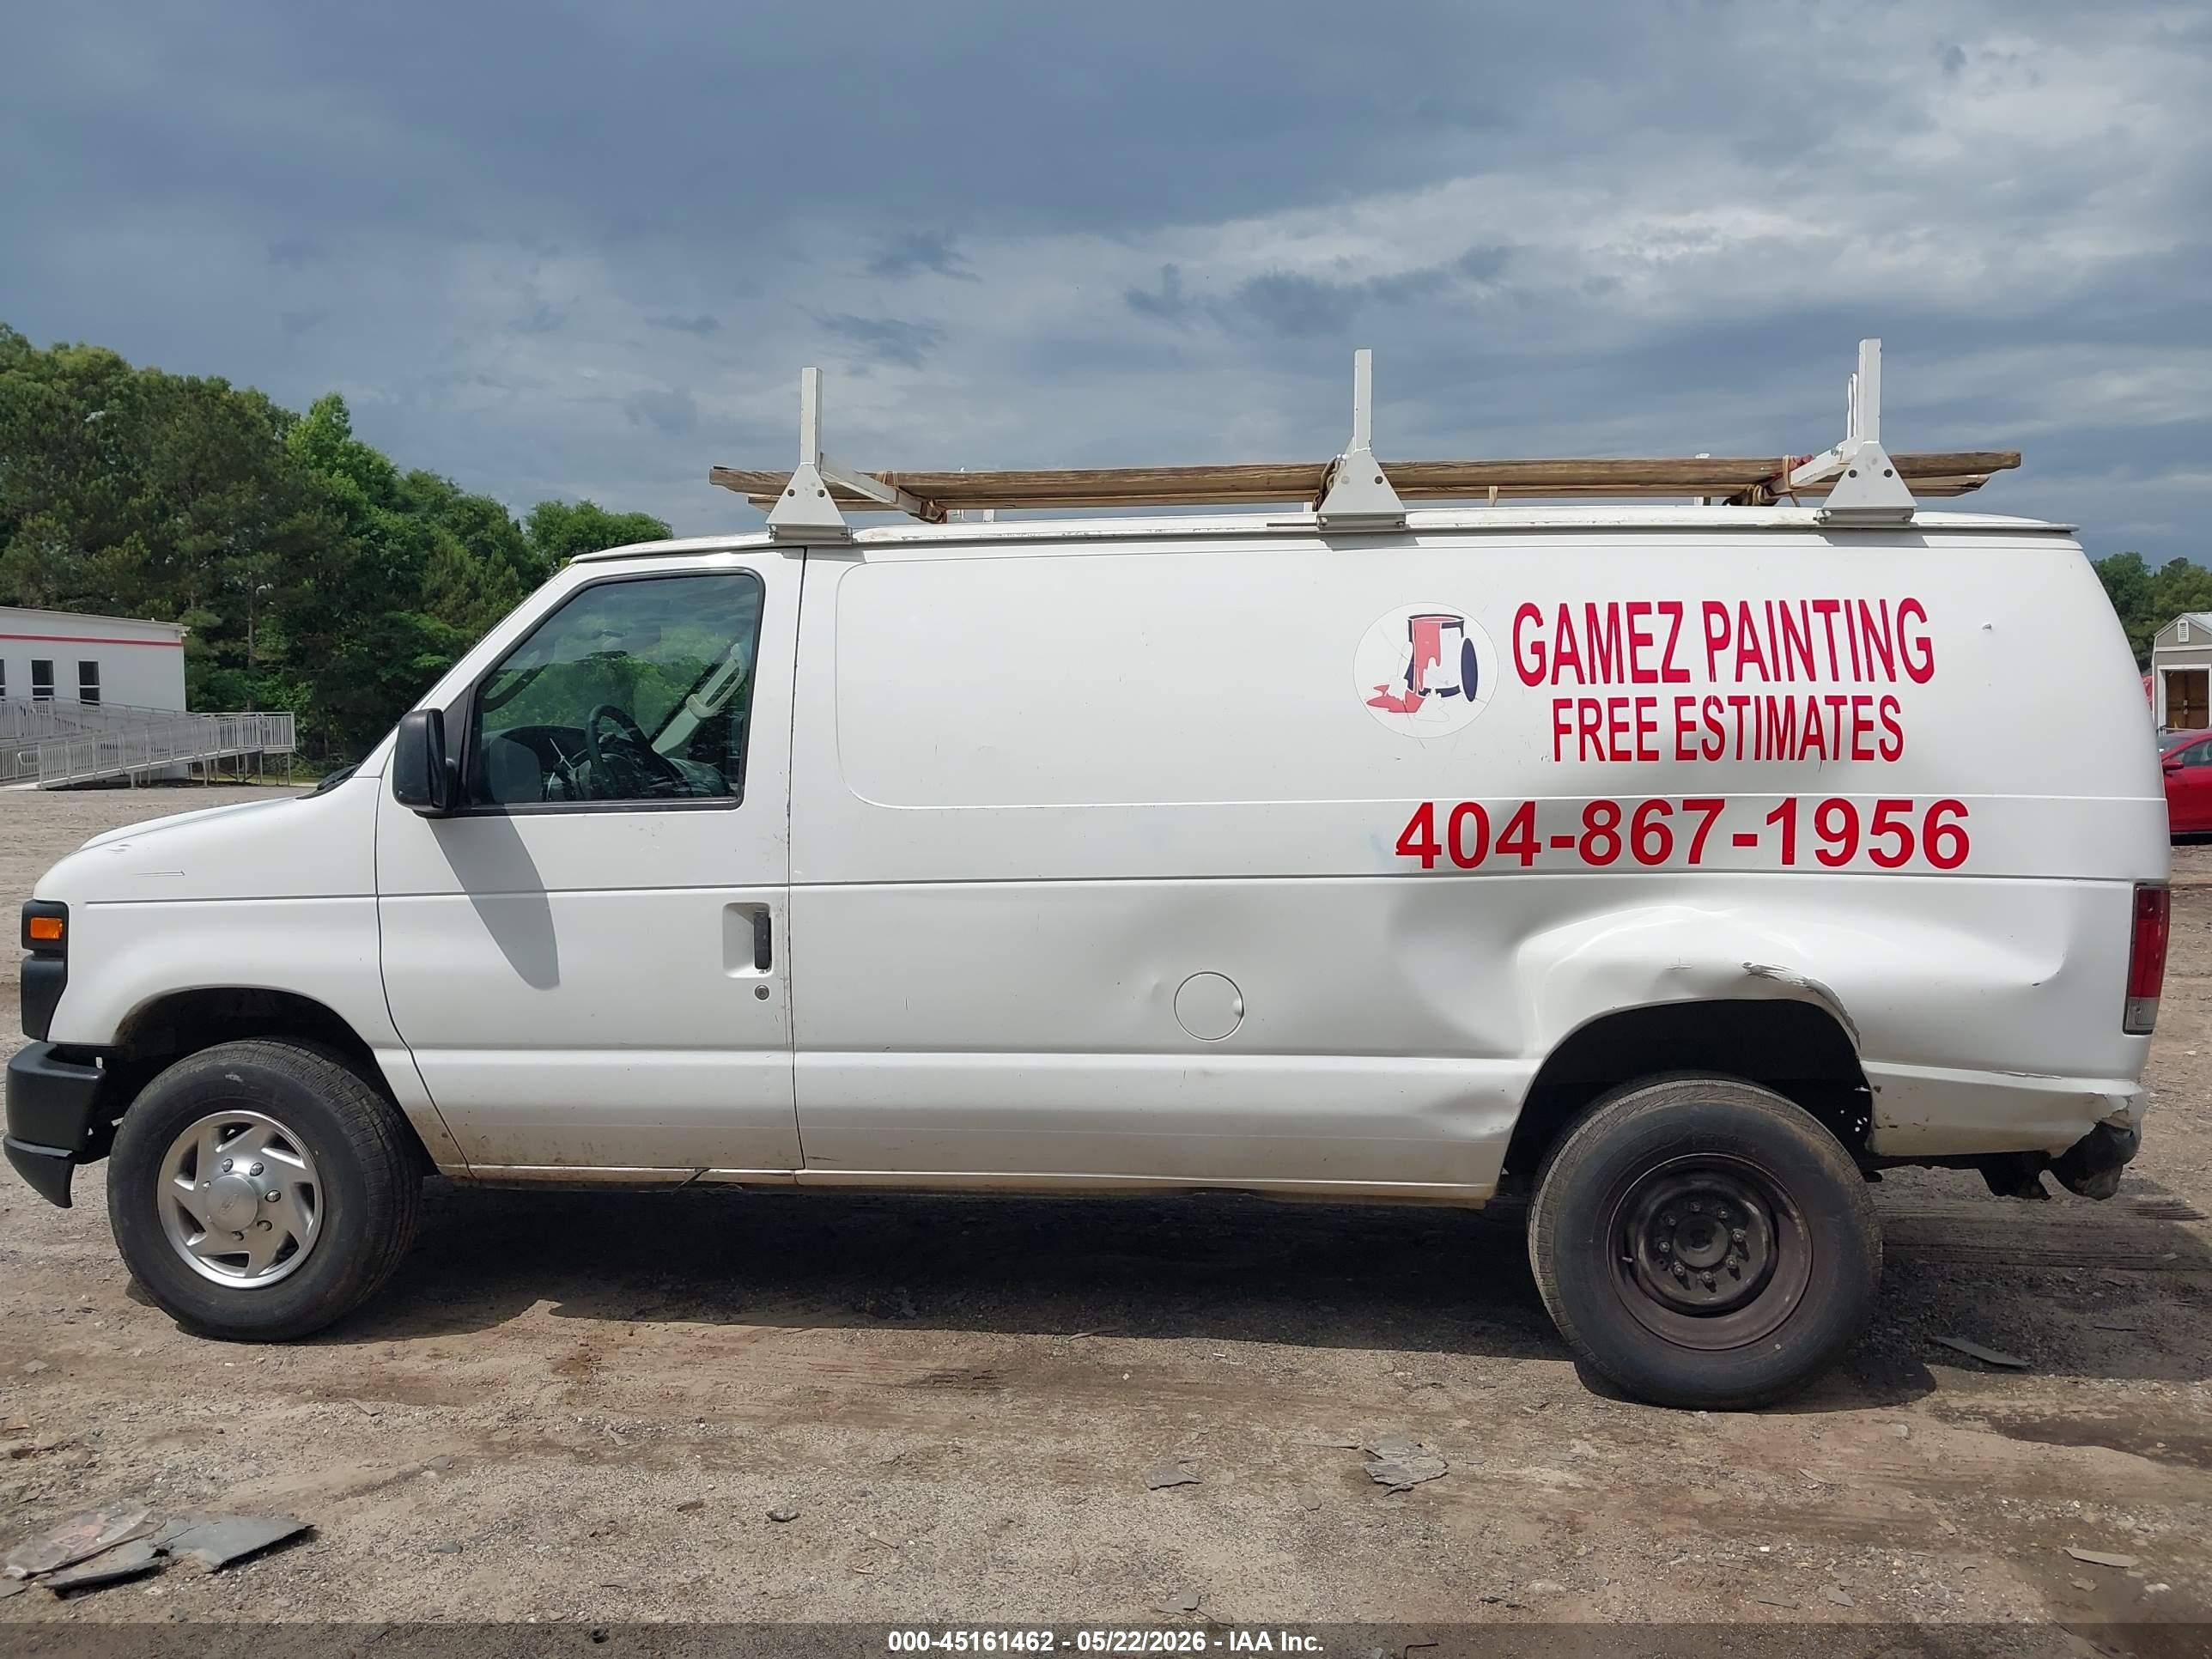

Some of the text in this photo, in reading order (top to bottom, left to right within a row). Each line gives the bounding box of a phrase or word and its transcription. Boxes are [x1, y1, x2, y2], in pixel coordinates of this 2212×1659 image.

[1513, 597, 1935, 688] GAMEZ PAINTING
[1553, 694, 1904, 763] FREE ESTIMATES
[1395, 797, 1970, 870] 404-867-1956
